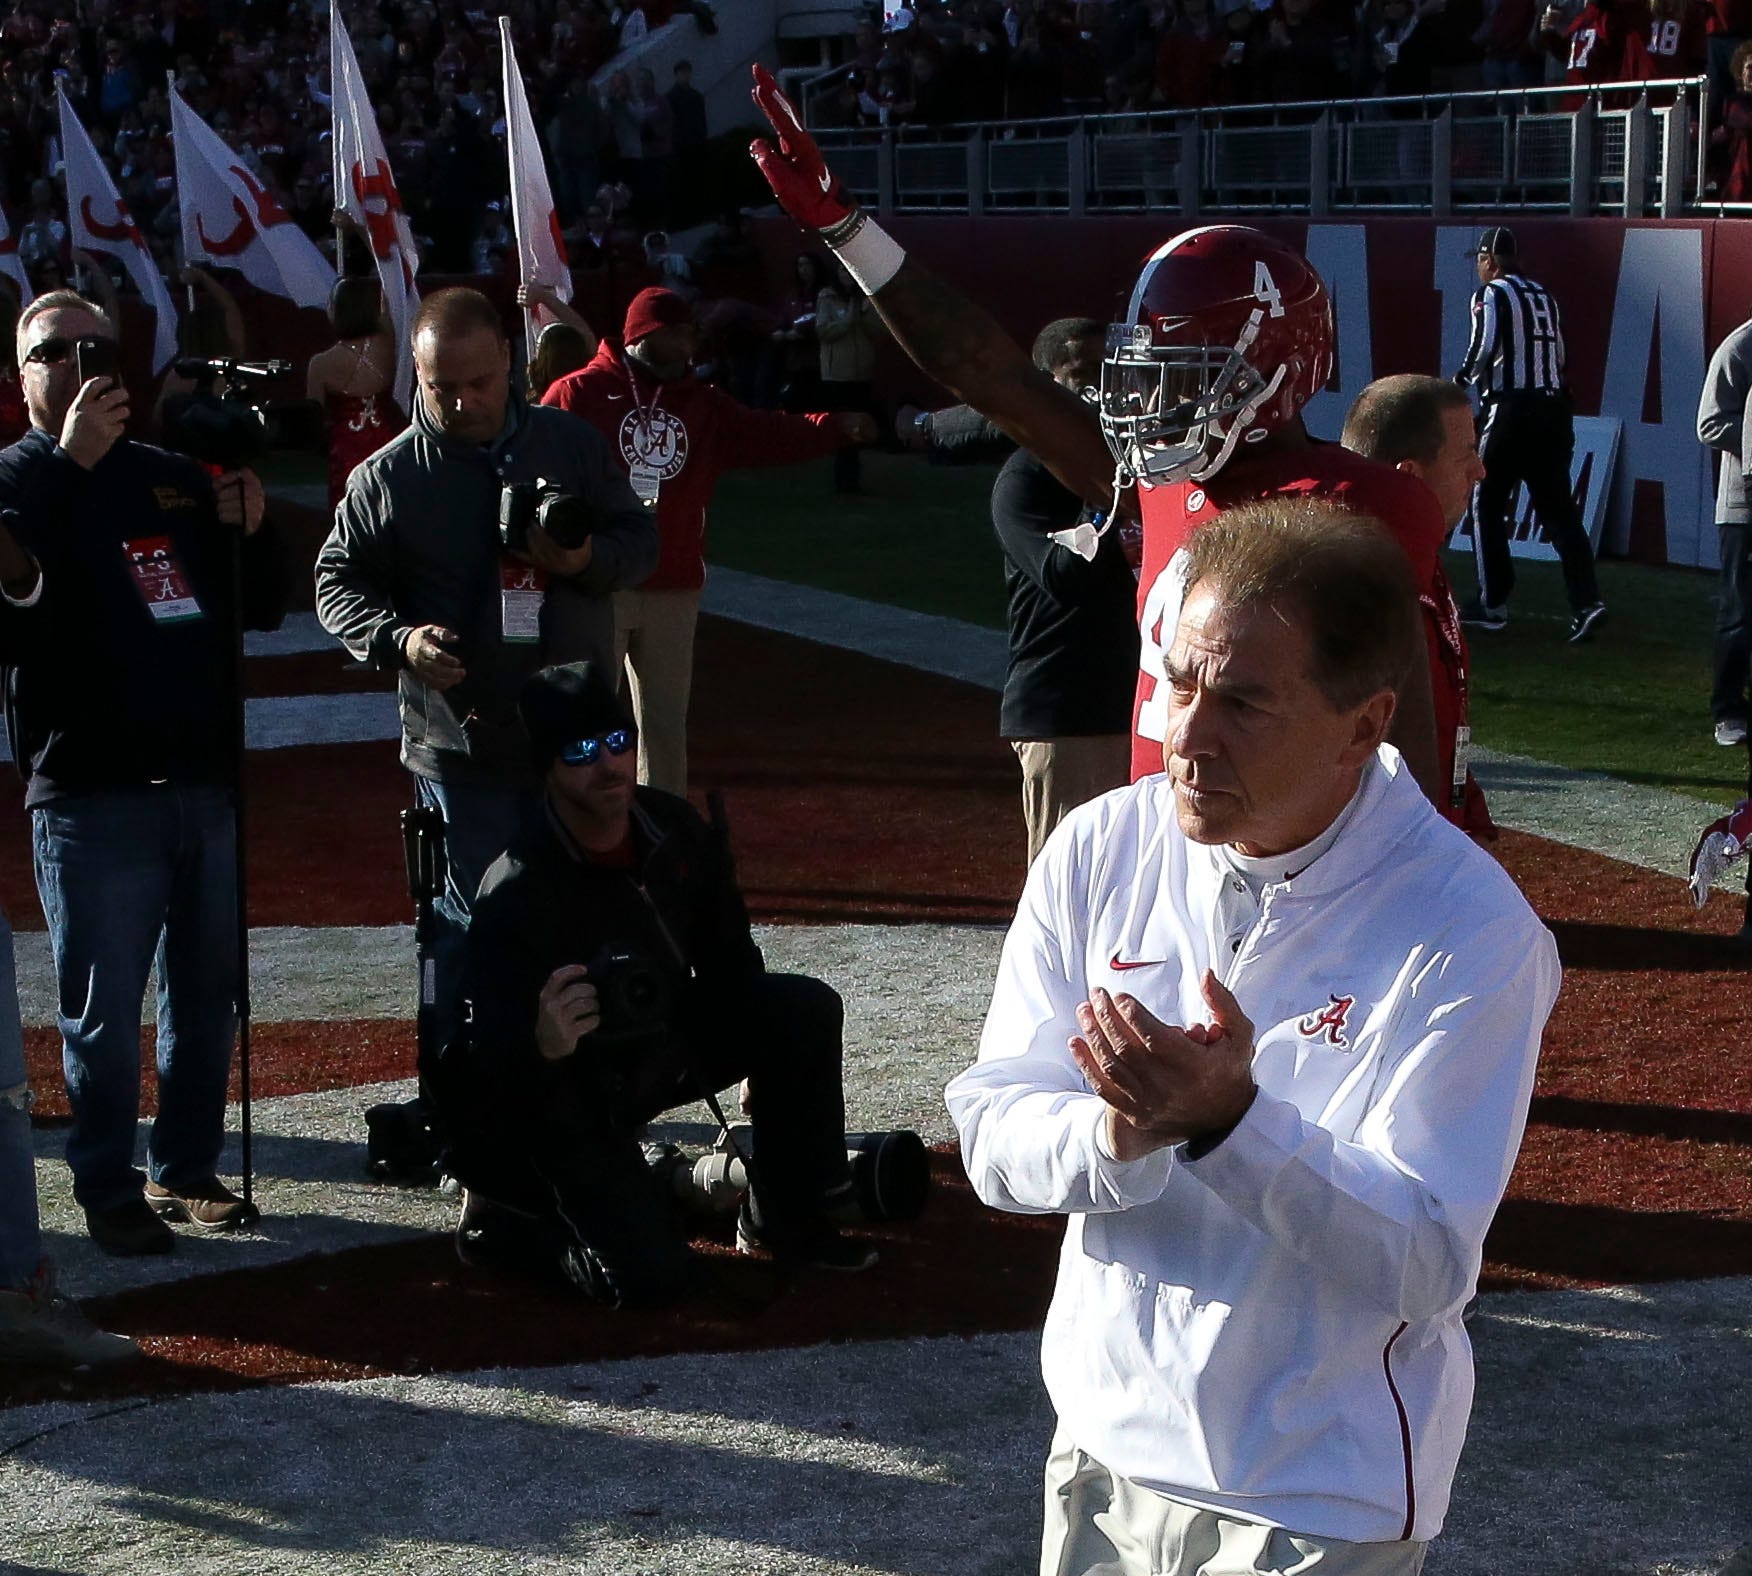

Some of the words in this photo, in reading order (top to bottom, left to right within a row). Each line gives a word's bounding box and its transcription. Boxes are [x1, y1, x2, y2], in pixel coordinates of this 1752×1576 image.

[1567, 29, 1596, 69] 17
[1648, 20, 1680, 55] 18
[1254, 261, 1285, 318] 4
[1524, 292, 1555, 337] H
[1299, 993, 1354, 1046] A
